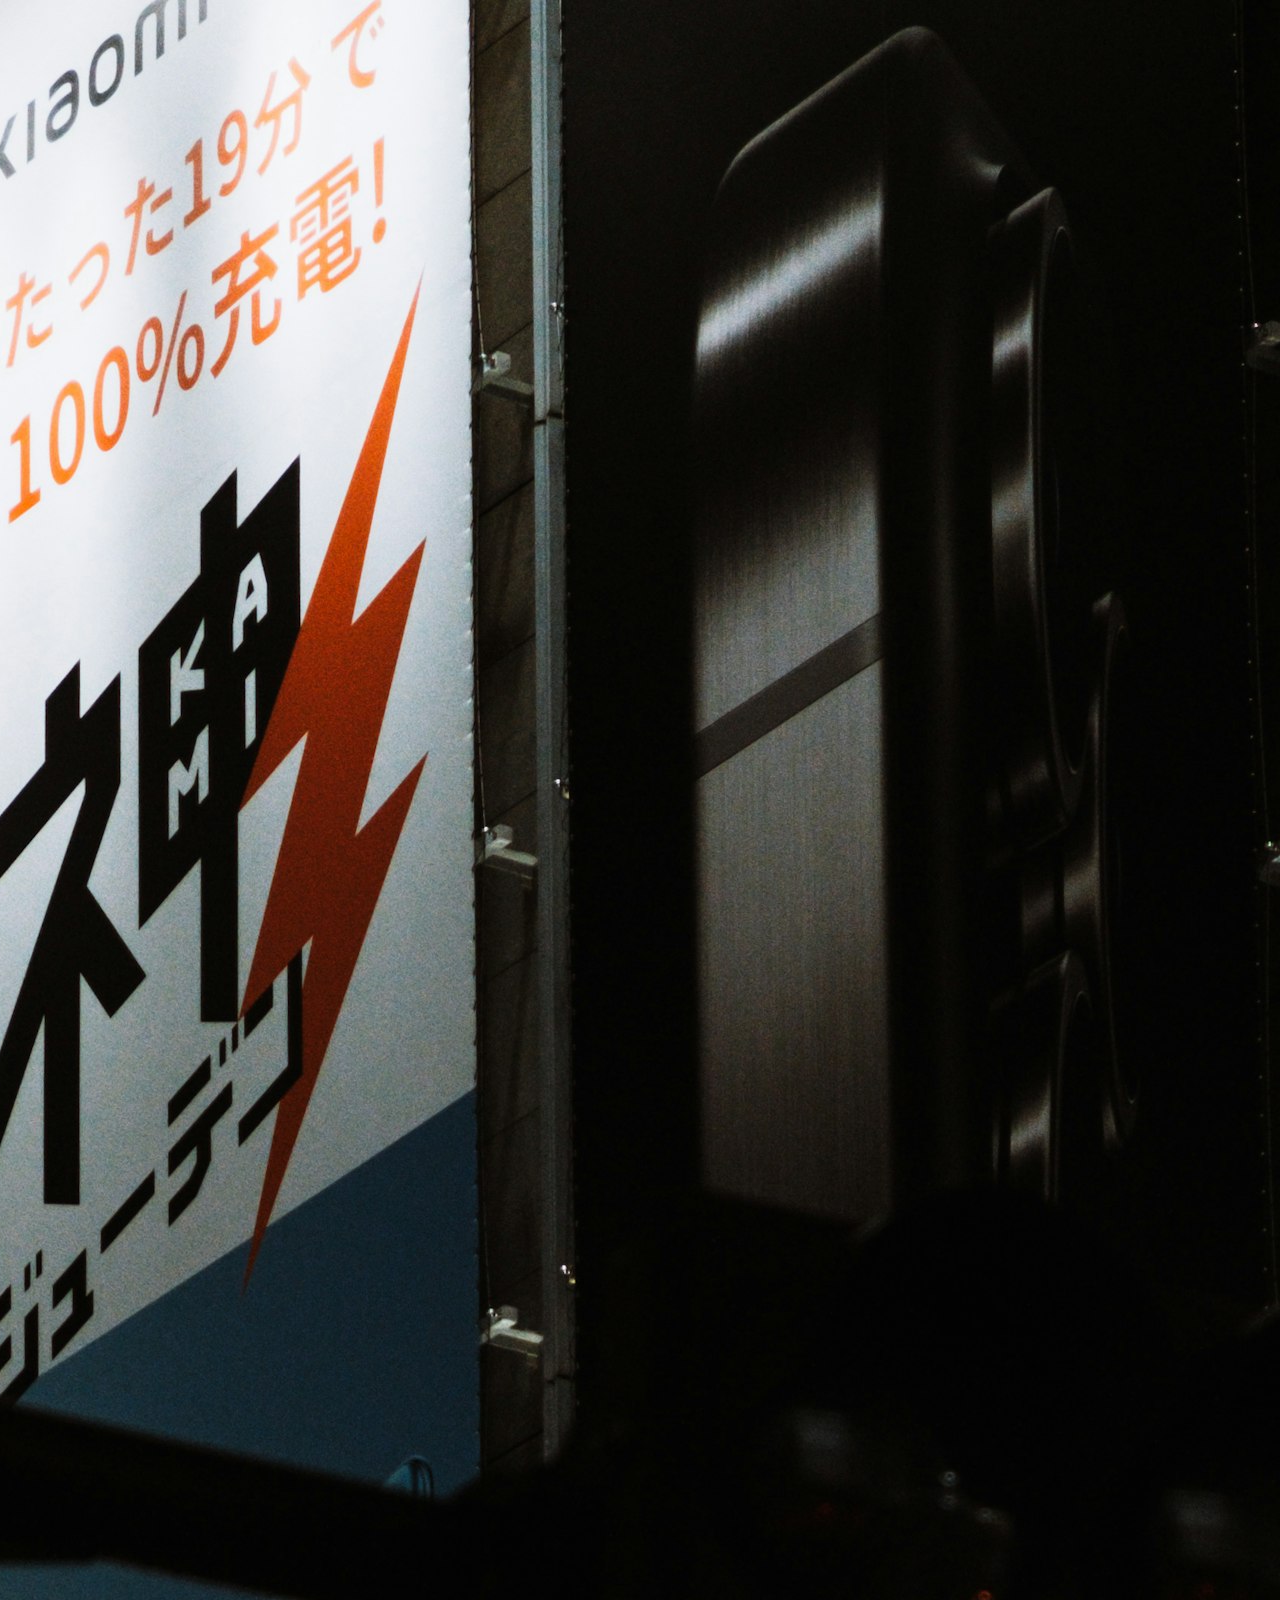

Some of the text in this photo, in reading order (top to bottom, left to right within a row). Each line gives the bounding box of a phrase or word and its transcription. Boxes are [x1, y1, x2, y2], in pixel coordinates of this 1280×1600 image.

[5, 0, 387, 367] たった19分で
